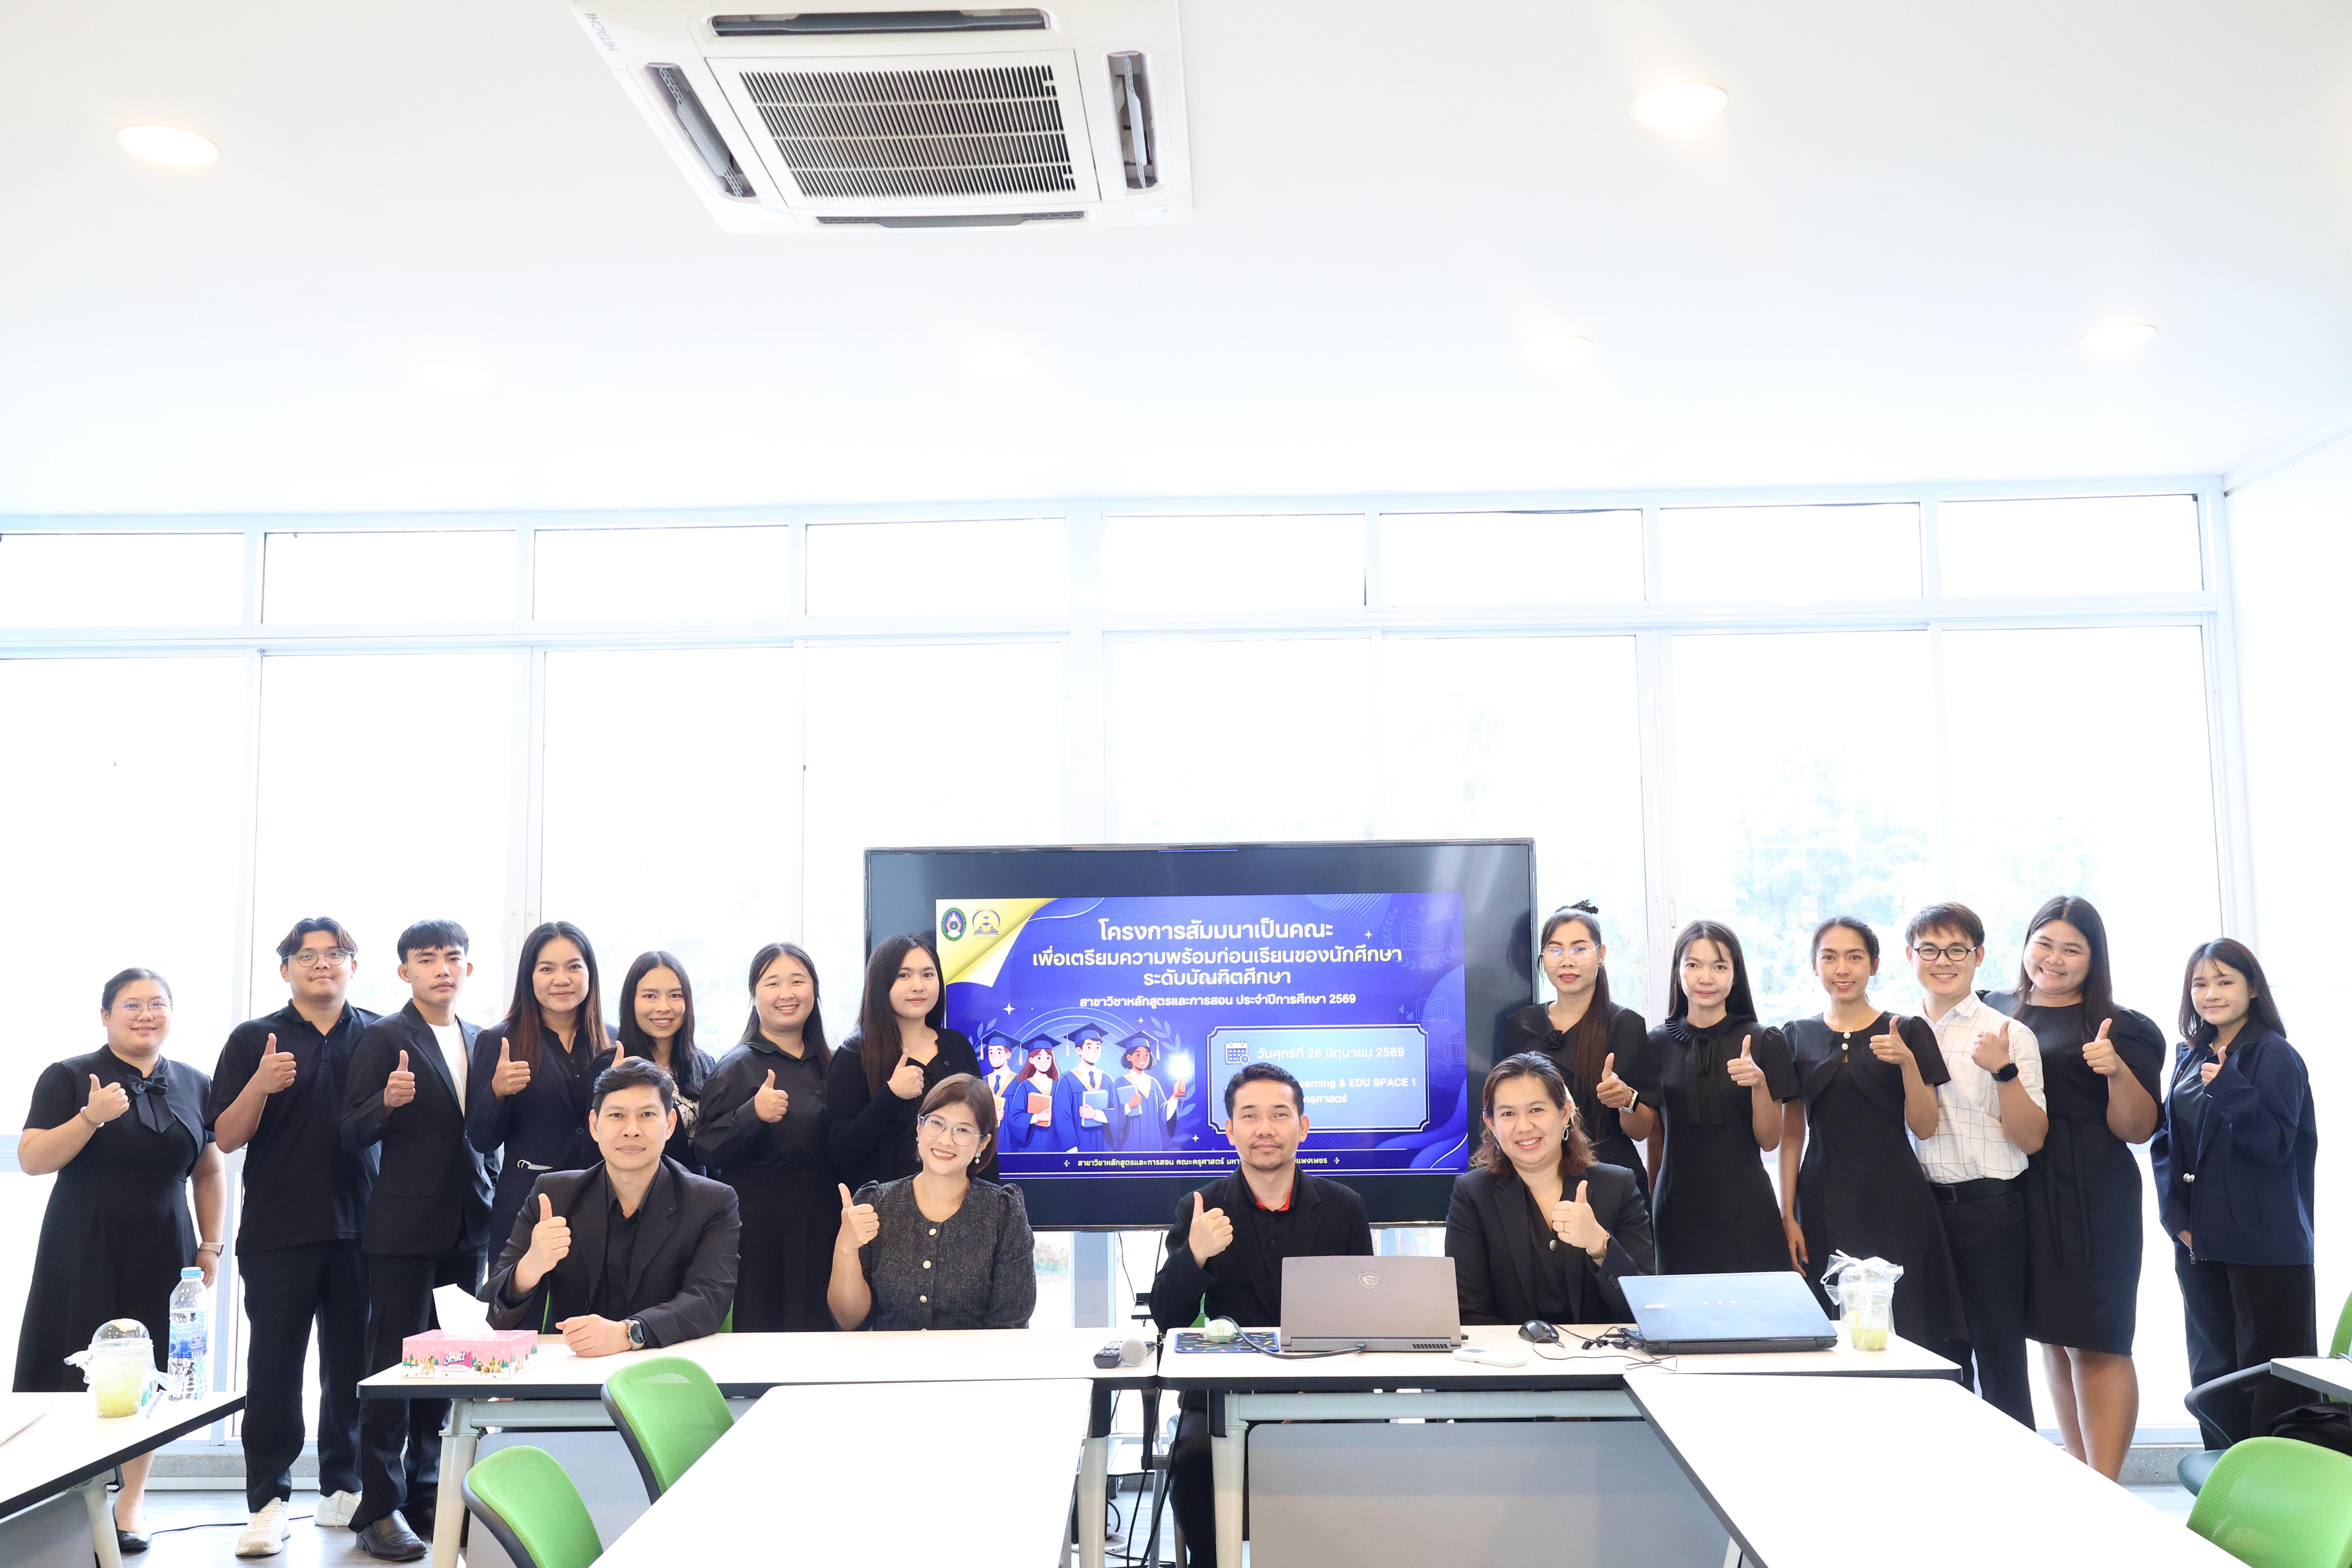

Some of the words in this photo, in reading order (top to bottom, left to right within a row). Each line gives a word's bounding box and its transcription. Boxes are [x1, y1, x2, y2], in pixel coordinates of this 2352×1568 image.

[584, 13, 619, 51] HITACHI
[1098, 918, 1333, 940] โครงการสัมมนาเป็นคณะ
[1033, 944, 1402, 966] เพื่อเตรียมความพร้อมก่อนเรียนของนักศึกษา
[1143, 967, 1291, 986] ระดับบัณฑิตศึกษา
[1080, 995, 1233, 1009] สาขาวิชาหลักสูตรและการสอน
[1236, 993, 1326, 1005] ประจำปีการศึกษา
[1329, 993, 1356, 1004] 2569
[1257, 1045, 1305, 1062] วันศุกร์ที่
[1307, 1048, 1322, 1058] 26
[1325, 1047, 1373, 1060] มิถุนายน
[1376, 1047, 1405, 1058] 2569
[1299, 1079, 1336, 1090] earning
[1339, 1078, 1346, 1087] &
[1349, 1078, 1370, 1087] EDU
[1373, 1078, 1408, 1087] SPACE
[1411, 1078, 1416, 1086] 1
[1303, 1093, 1348, 1106] ครุศาสตร์
[1078, 1158, 1174, 1168] สาขาวิชาหลักสูตรและการสอน
[1176, 1157, 1225, 1167] คณะครุศาสตร์
[443, 1351, 466, 1366] Scott
